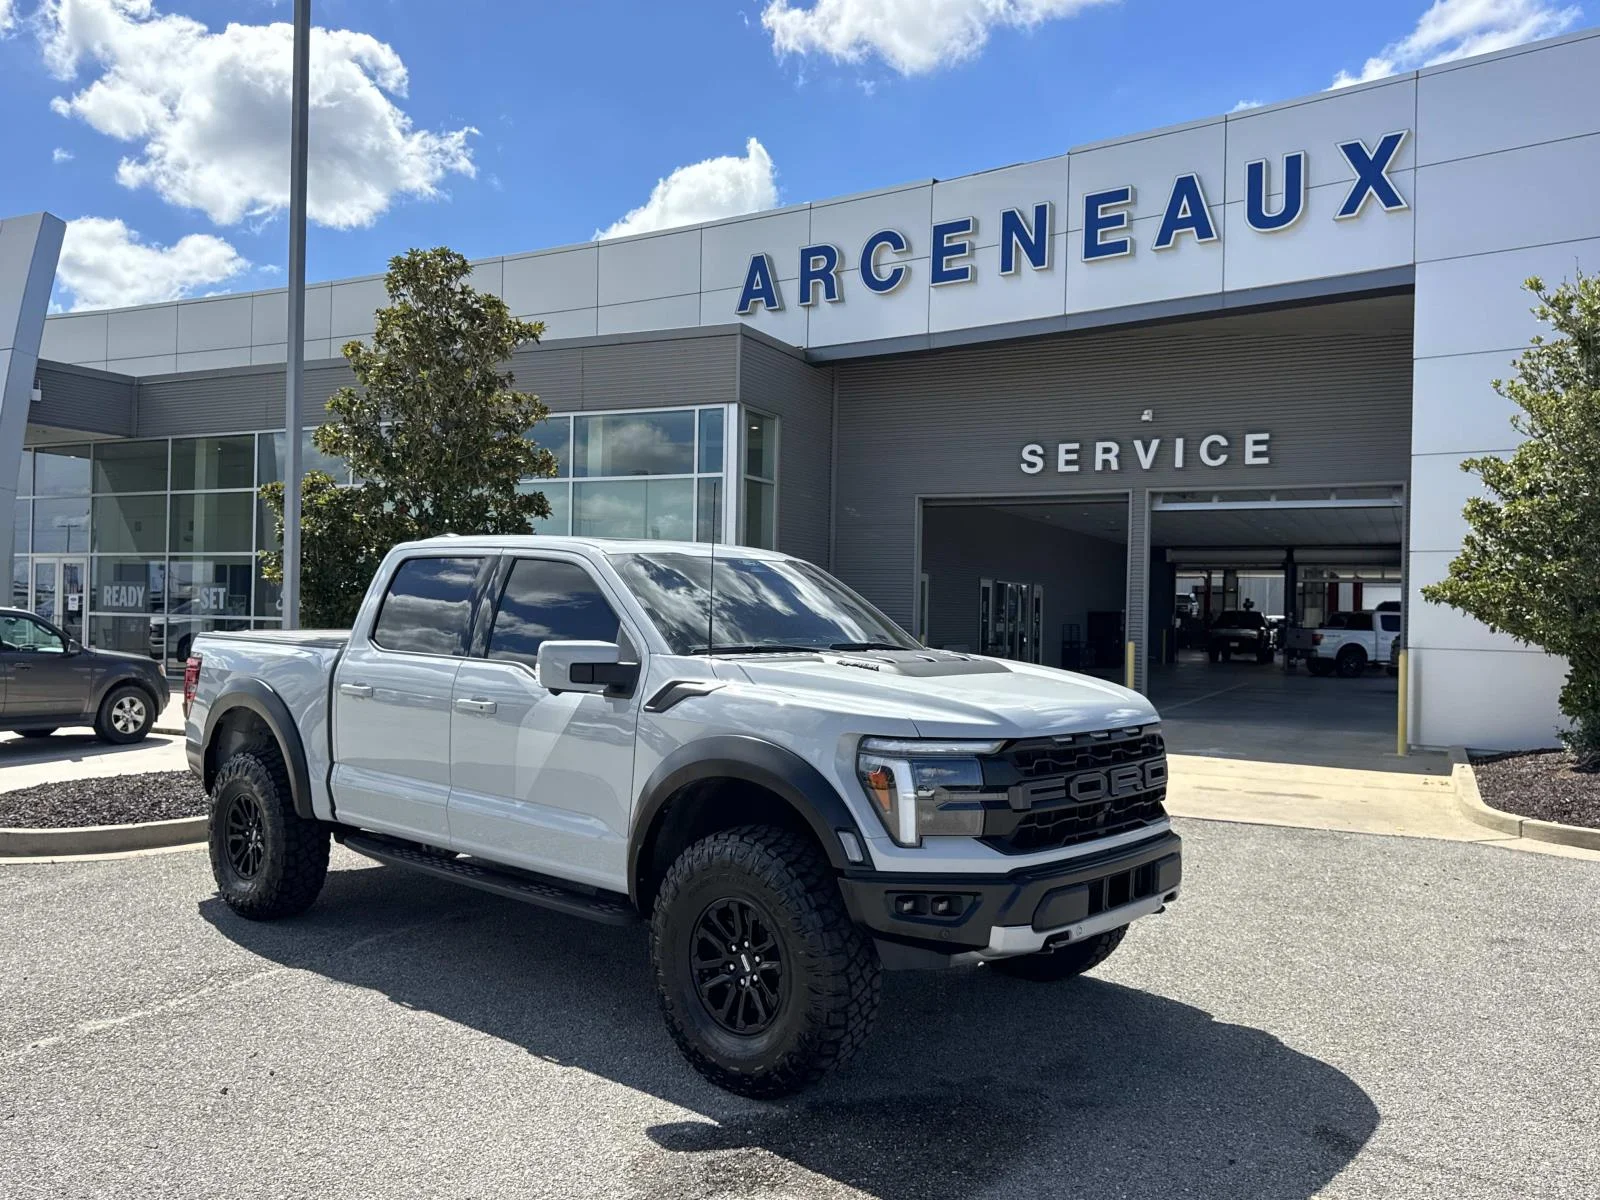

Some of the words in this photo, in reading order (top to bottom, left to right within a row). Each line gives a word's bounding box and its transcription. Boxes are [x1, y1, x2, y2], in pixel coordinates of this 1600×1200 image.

[736, 129, 1410, 314] ARCENEAUX
[1020, 432, 1270, 474] SERVICE
[103, 585, 145, 608] READY
[200, 586, 227, 610] SET
[1008, 759, 1168, 810] FORD
